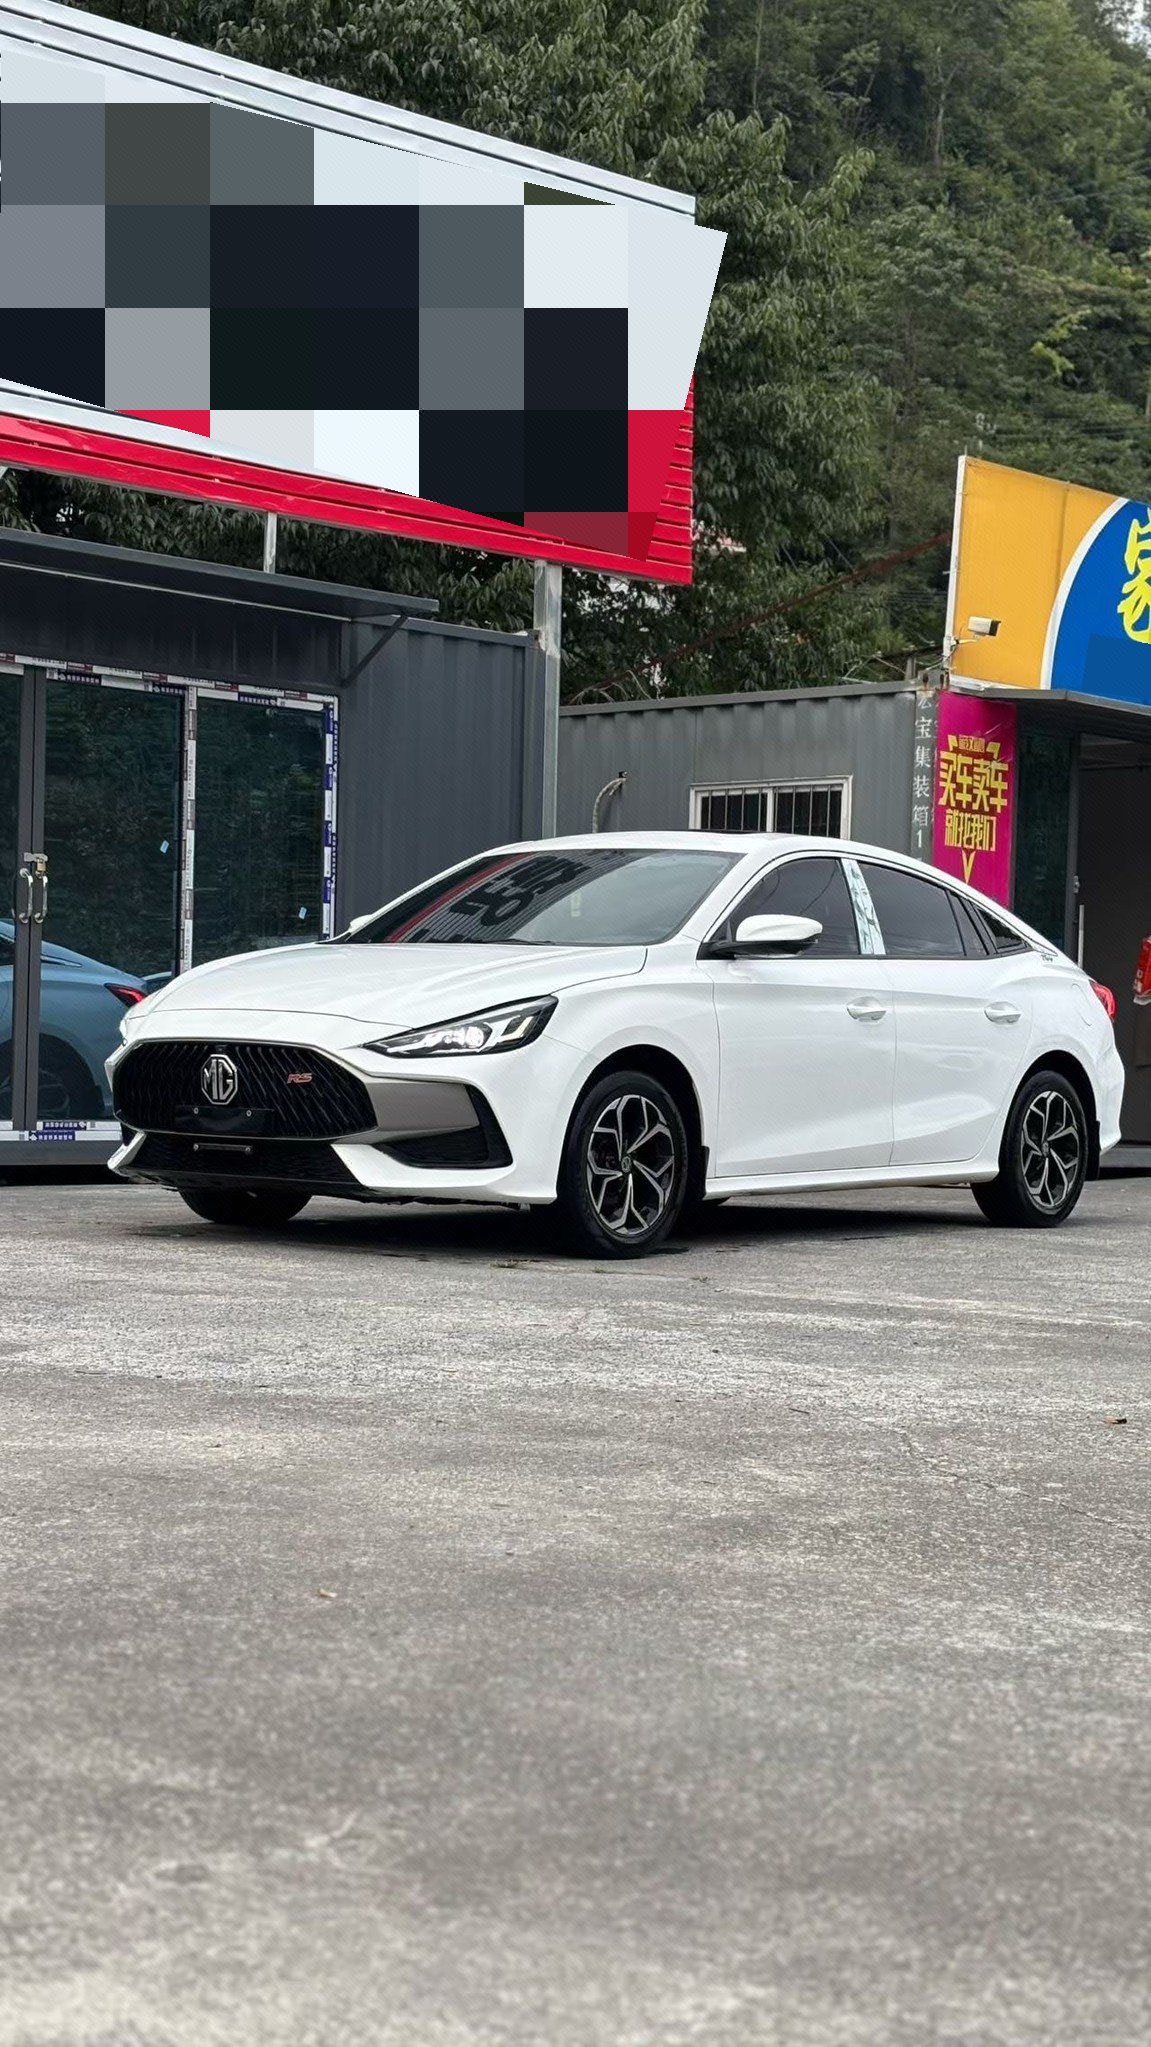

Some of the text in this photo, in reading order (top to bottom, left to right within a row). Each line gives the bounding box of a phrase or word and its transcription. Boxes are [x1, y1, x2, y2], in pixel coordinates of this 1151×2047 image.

[912, 698, 932, 862] 宝集装箱1
[938, 750, 1009, 813] 买车卖车
[944, 809, 997, 852] 就找我们
[202, 1057, 236, 1102] MG
[287, 1072, 313, 1084] RS
